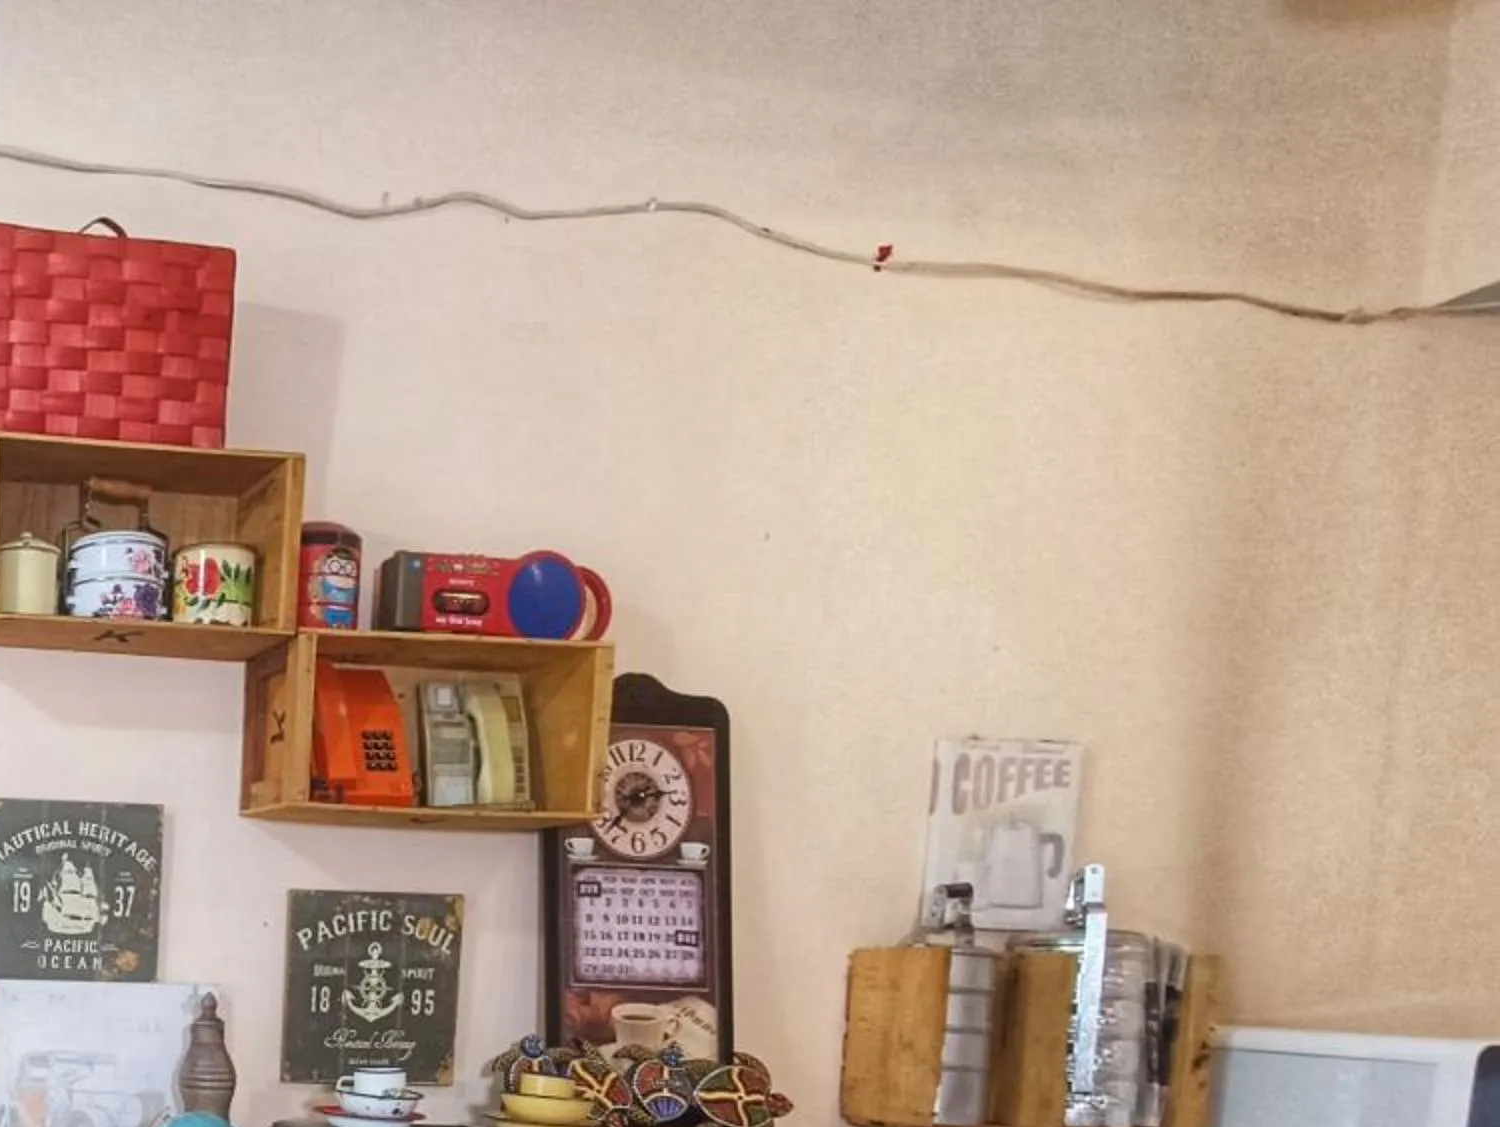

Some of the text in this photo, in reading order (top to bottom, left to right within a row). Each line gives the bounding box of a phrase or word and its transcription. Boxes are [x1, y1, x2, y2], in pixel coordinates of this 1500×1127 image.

[629, 743, 646, 763] 12
[952, 753, 1072, 815] COFFEE
[78, 821, 157, 873] HERITAGE
[631, 831, 646, 854] 6
[12, 880, 32, 913] 19
[113, 886, 136, 918] 37
[43, 937, 99, 954] PACIFIC
[296, 910, 455, 955] PACIFIC SOUL
[37, 955, 103, 970] OCEAN
[310, 986, 331, 1013] 18
[411, 989, 436, 1016] 95
